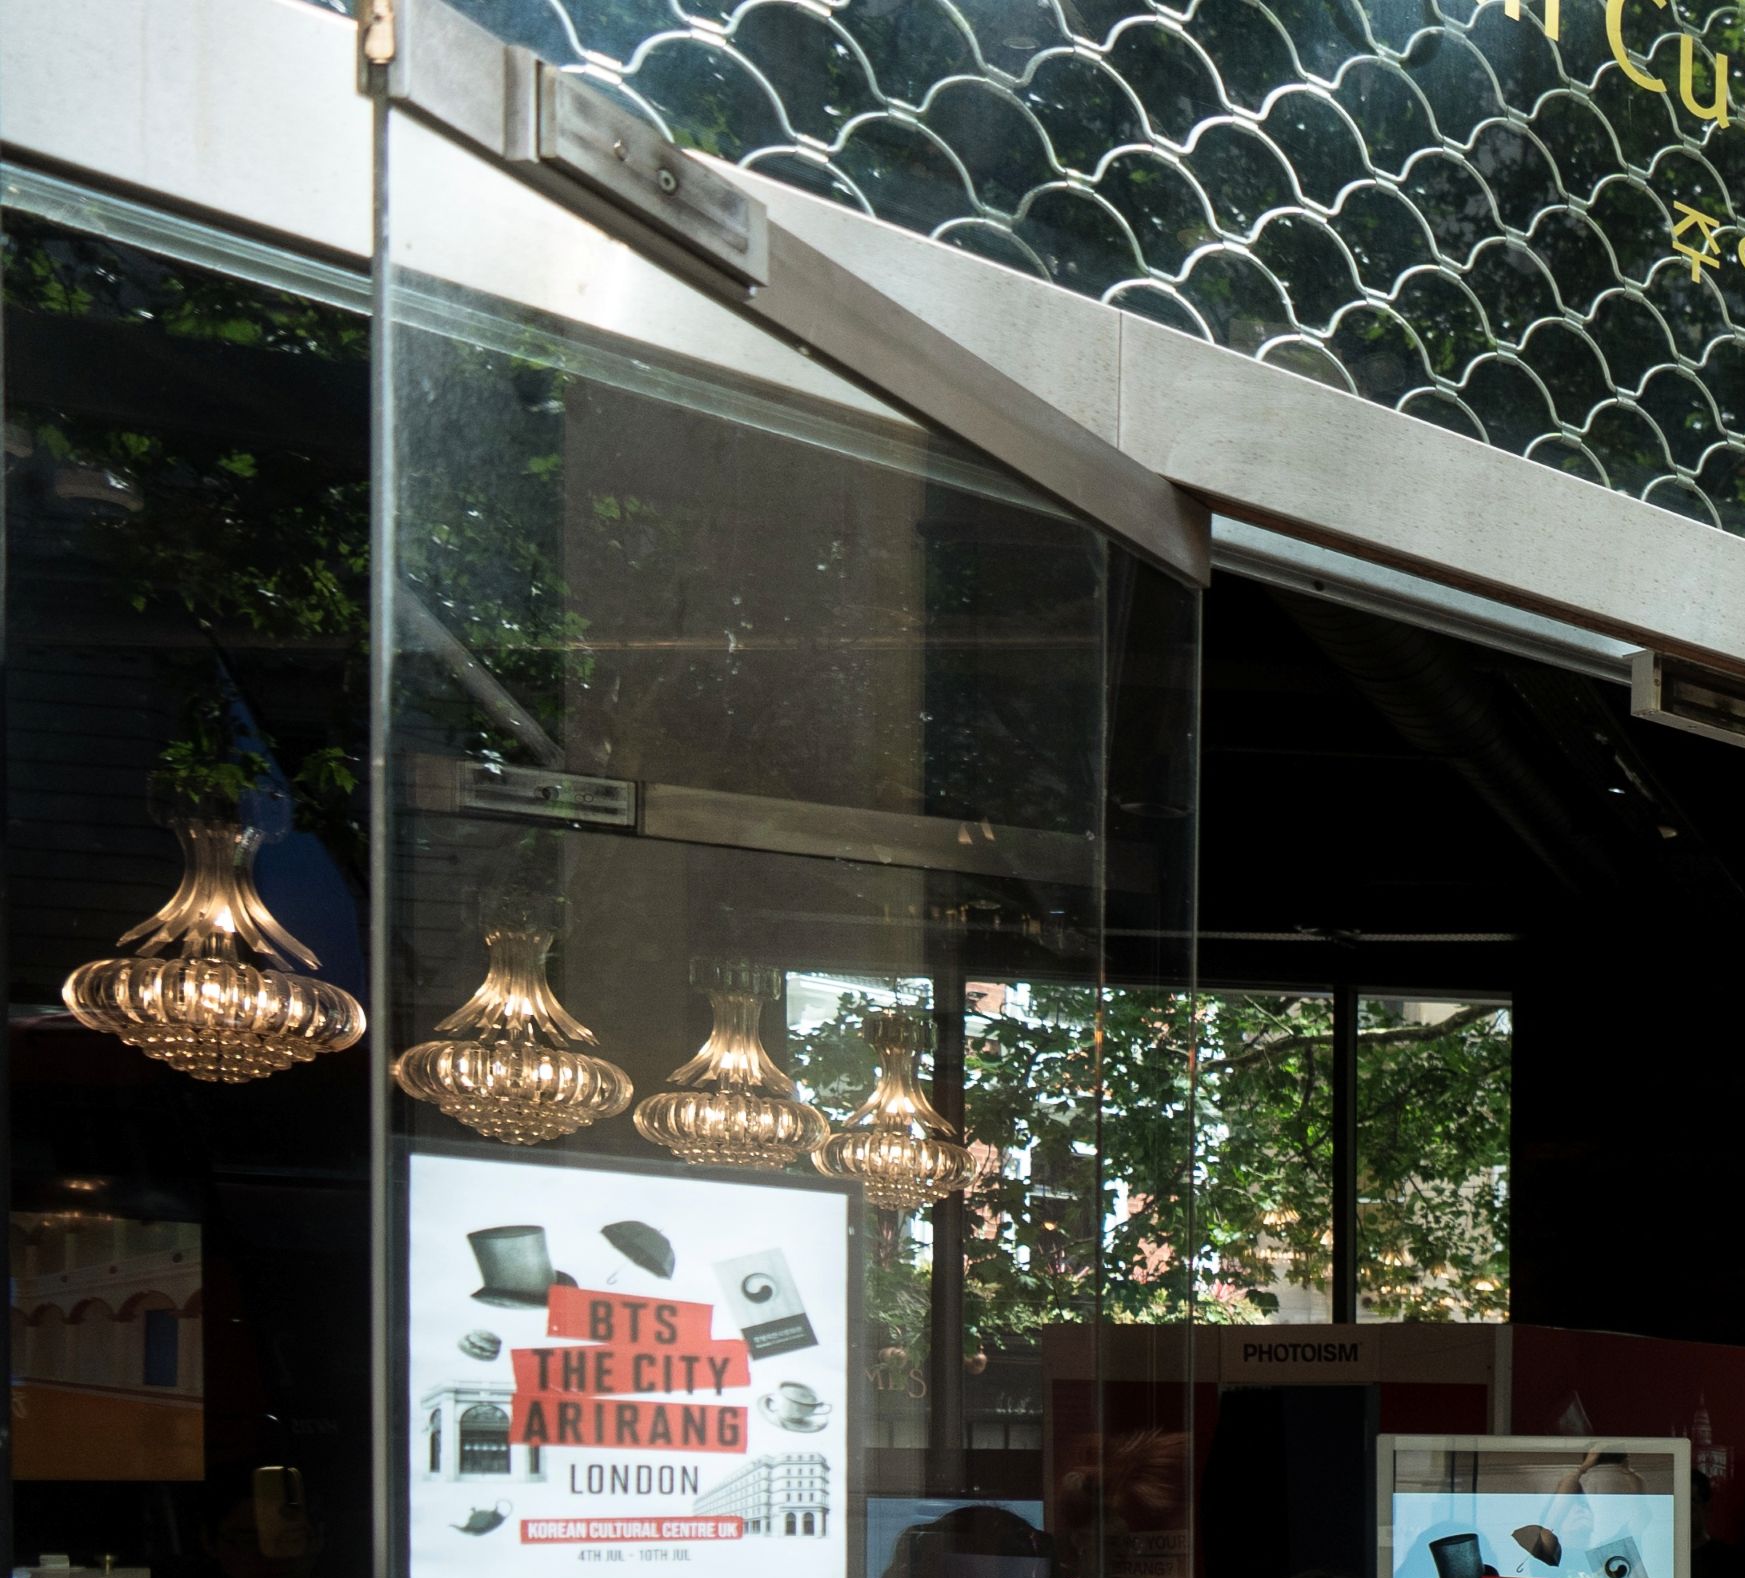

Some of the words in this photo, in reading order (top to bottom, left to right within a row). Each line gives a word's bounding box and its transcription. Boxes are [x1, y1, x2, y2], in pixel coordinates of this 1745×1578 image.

[589, 1301, 678, 1345] BTS
[1243, 1343, 1359, 1363] PHOTOISM
[533, 1349, 614, 1394] THE
[633, 1353, 731, 1396] CITY
[524, 1403, 741, 1447] ARIRANG
[569, 1463, 700, 1496] LONDON
[528, 1521, 586, 1539] KOREAN
[589, 1521, 659, 1539] CULTURAL
[662, 1521, 715, 1538] CENTRE
[718, 1521, 738, 1538] UK
[578, 1550, 600, 1562] 4TH
[604, 1550, 625, 1562] JUL
[640, 1549, 668, 1562] 10TH
[673, 1549, 691, 1561] JUL
